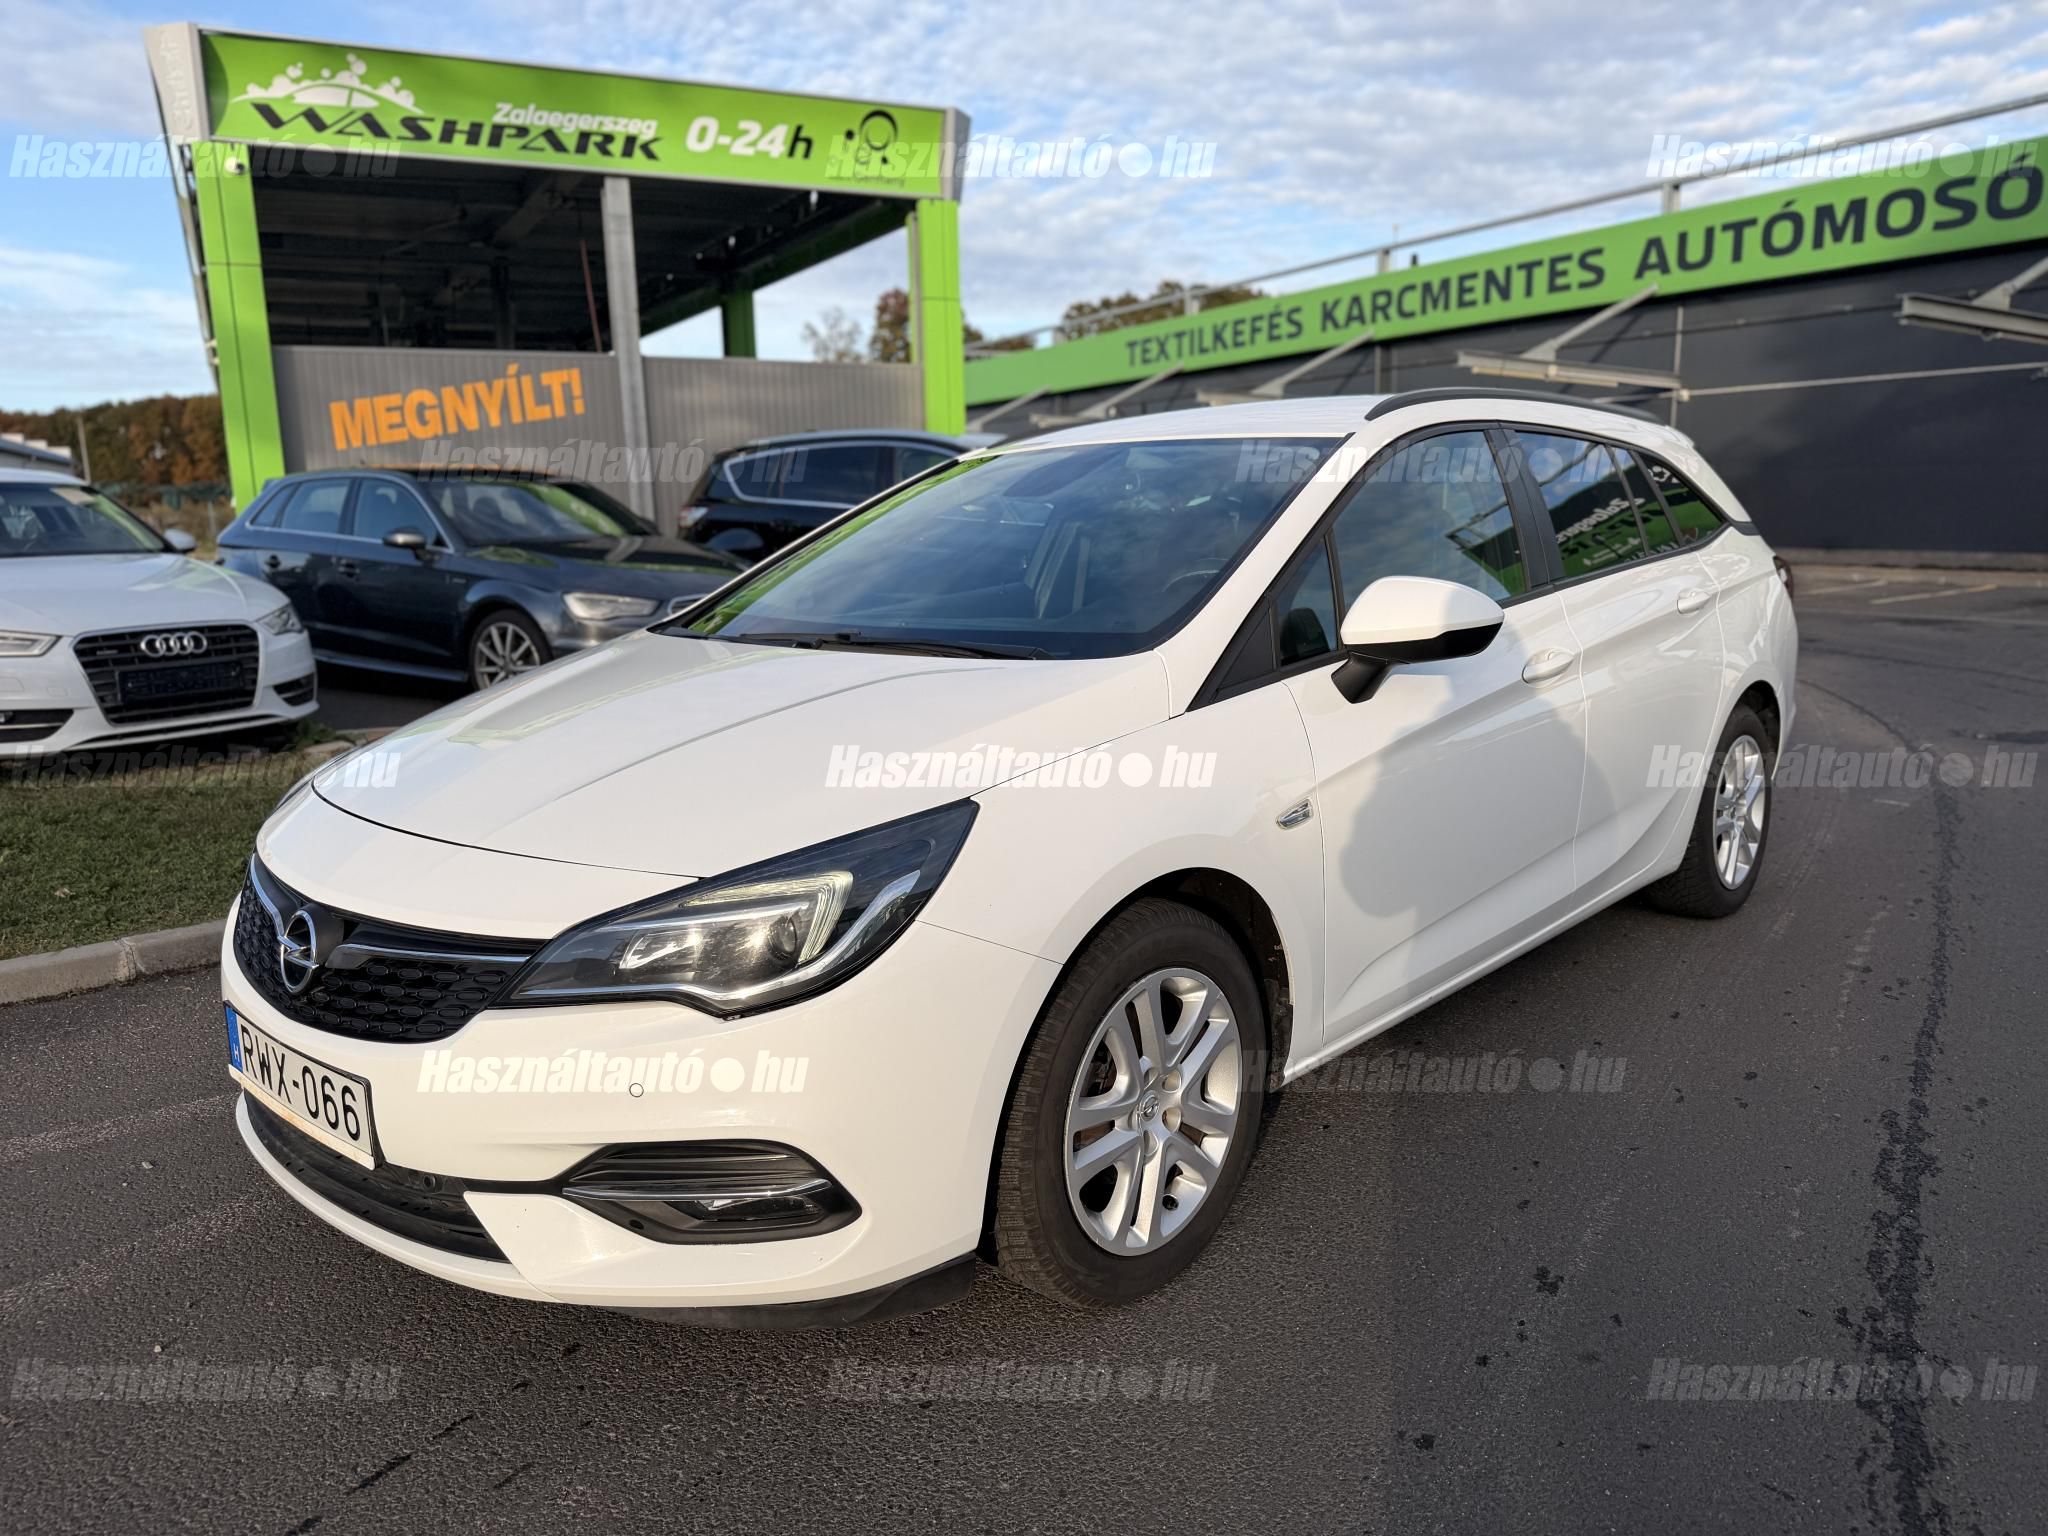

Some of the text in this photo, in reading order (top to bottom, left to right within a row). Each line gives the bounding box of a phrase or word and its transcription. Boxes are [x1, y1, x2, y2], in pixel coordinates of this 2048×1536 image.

[249, 102, 663, 162] WASHPARK
[491, 102, 658, 138] Zalaegerszeg
[1126, 150, 2045, 368] TEXTILKEFÉS KARCMENTES AUTÓMOSÓ
[329, 363, 586, 452] MEGNYÍLT!
[240, 1023, 361, 1142] RWX-066
